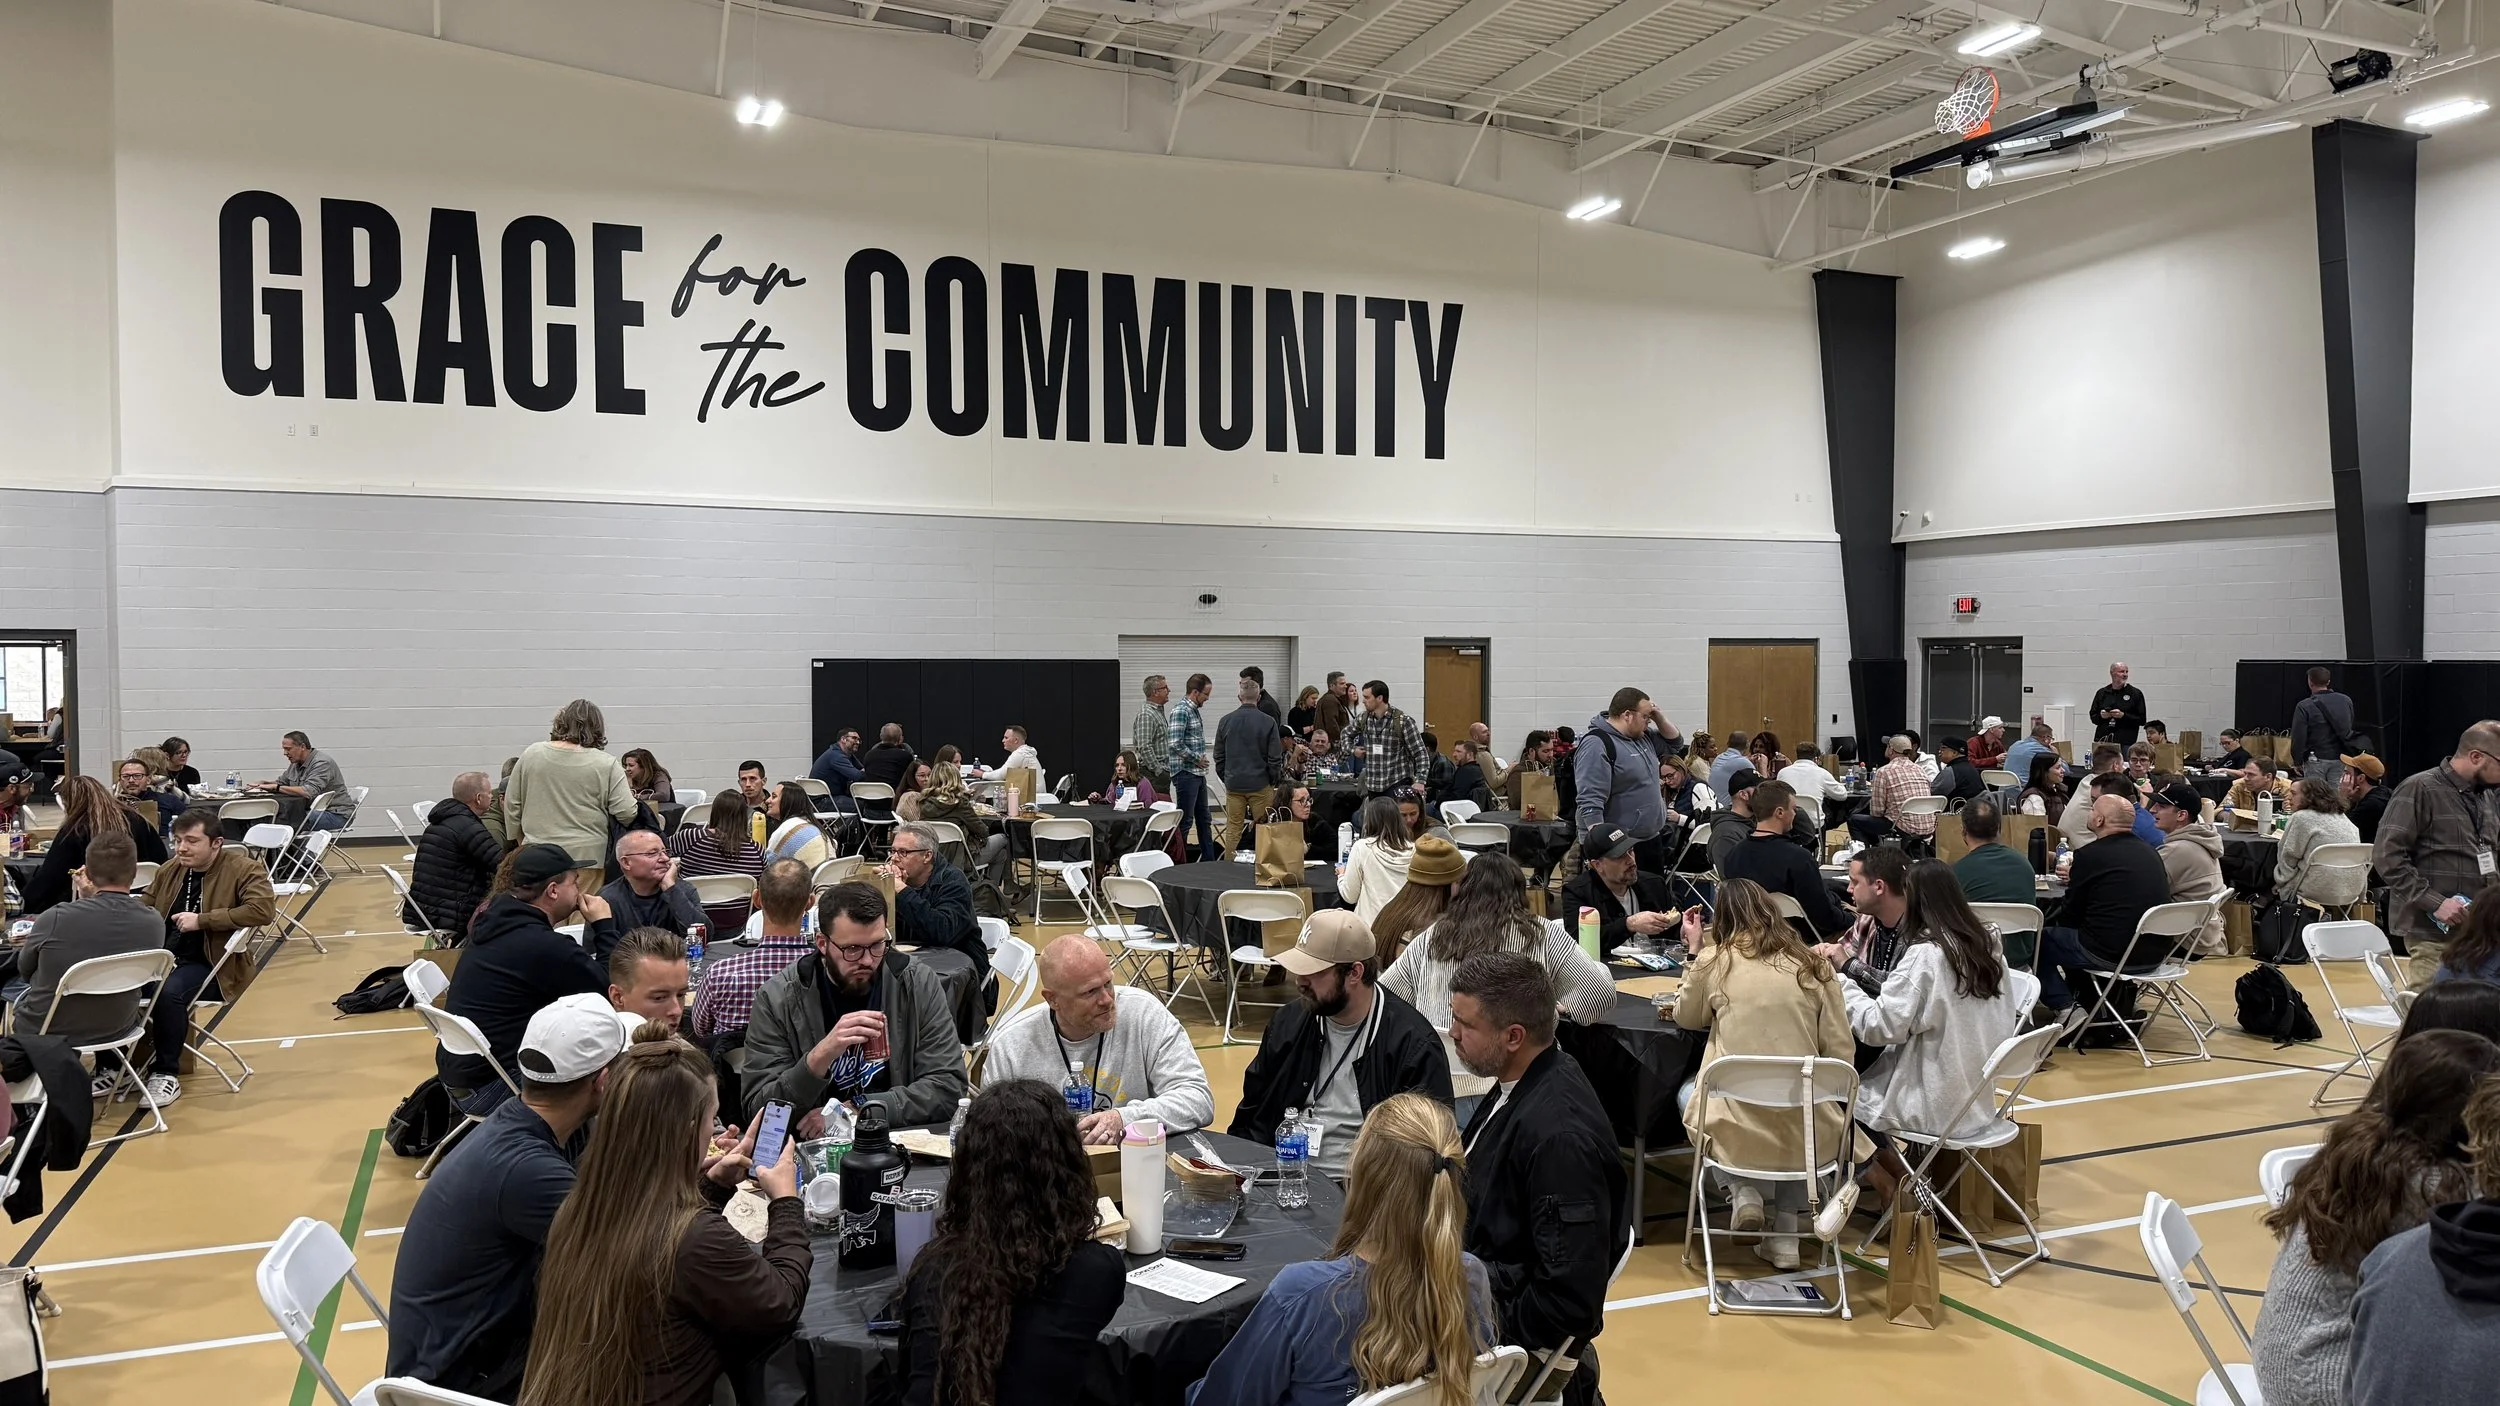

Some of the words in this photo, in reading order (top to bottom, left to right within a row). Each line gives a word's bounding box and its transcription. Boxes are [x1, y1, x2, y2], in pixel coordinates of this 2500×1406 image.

[219, 189, 646, 415] GRACE
[671, 233, 806, 318] for
[697, 318, 825, 423] the
[844, 247, 1463, 460] COMMUNITY
[1959, 598, 1972, 611] EXIT
[871, 1193, 896, 1203] SAFAR
